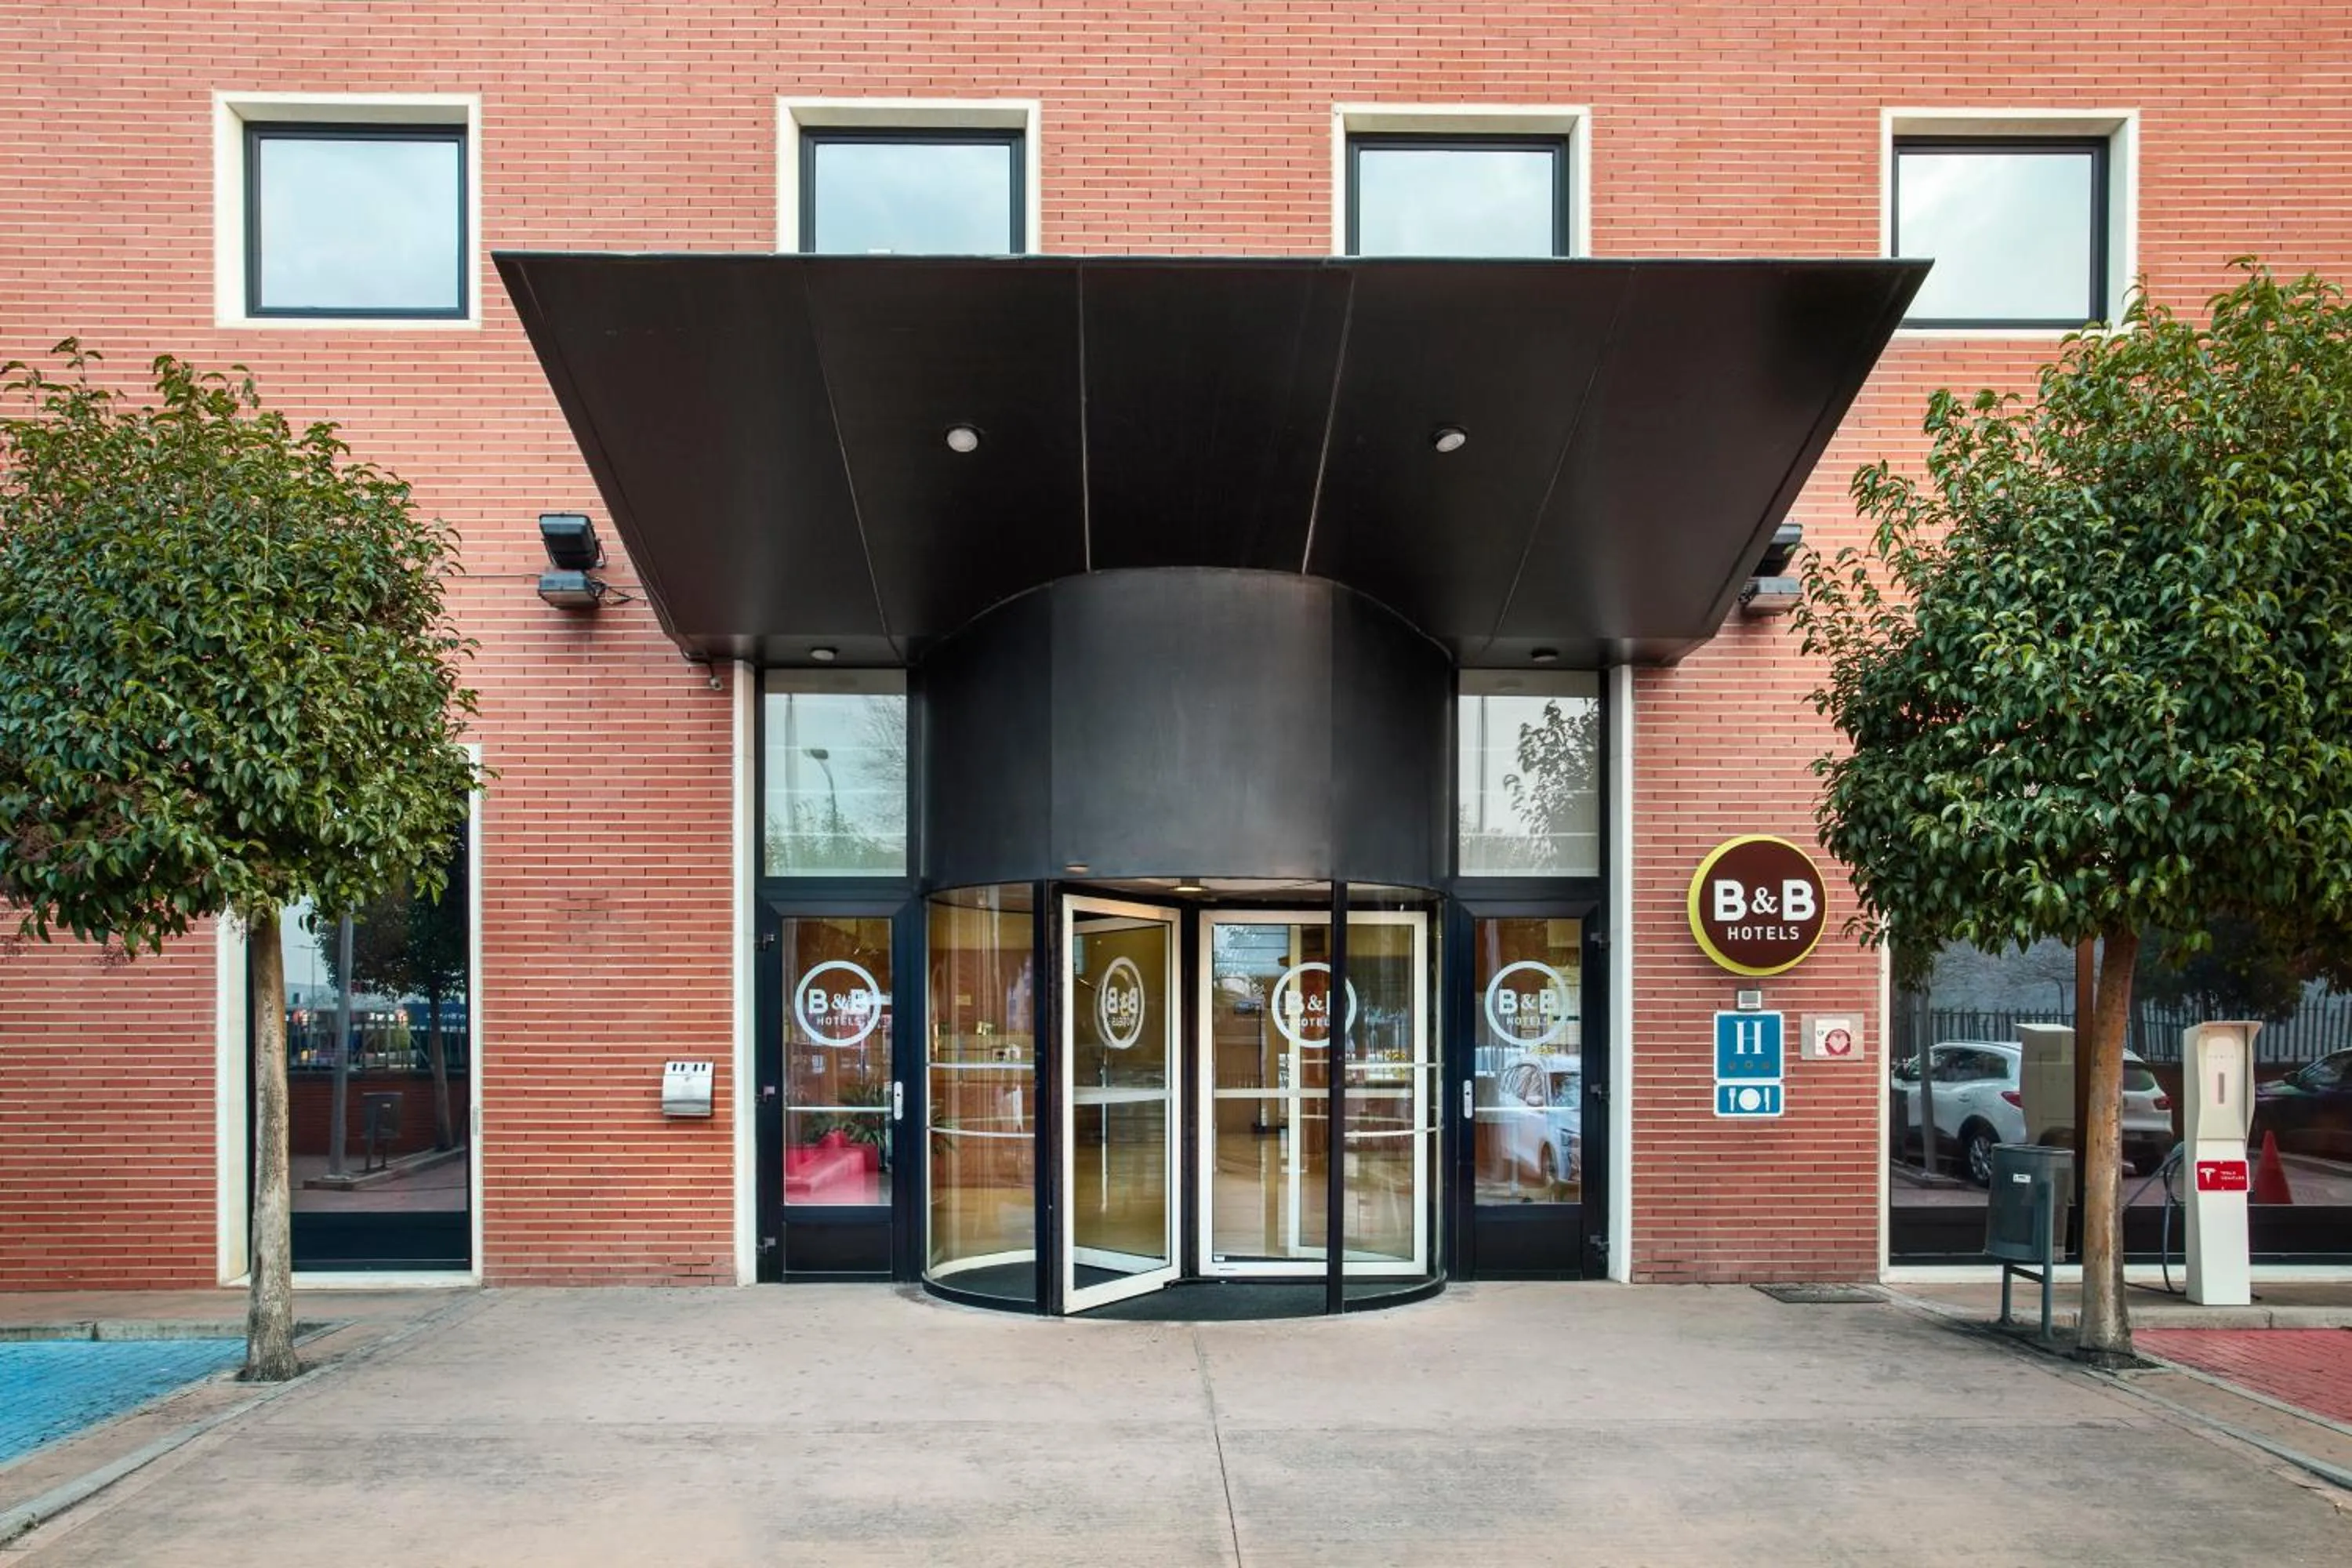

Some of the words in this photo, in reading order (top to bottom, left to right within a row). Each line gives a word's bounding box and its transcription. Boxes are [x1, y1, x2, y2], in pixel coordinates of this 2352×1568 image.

[1714, 879, 1816, 921] B&B
[1727, 926, 1800, 941] HOTELS
[808, 989, 870, 1014] B&B
[1285, 990, 1330, 1015] B&
[1499, 989, 1559, 1014] B&B
[1733, 1020, 1765, 1054] H
